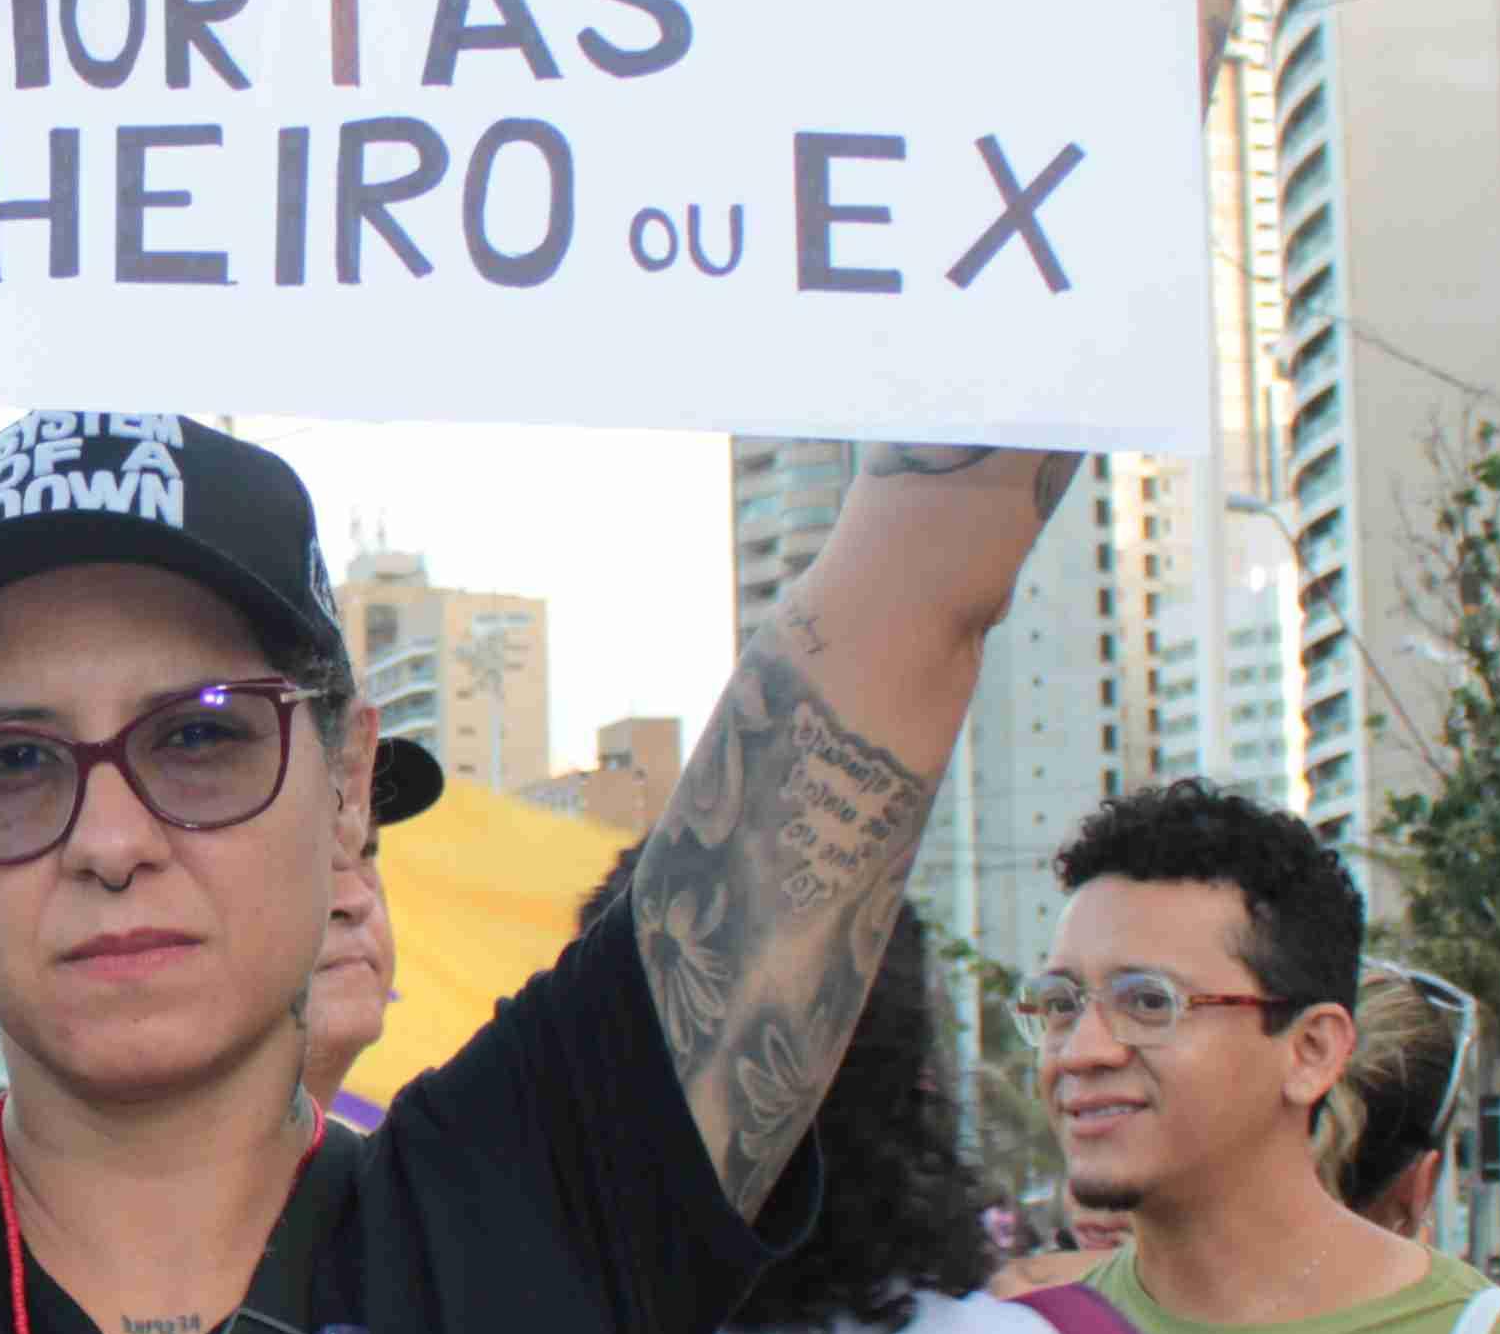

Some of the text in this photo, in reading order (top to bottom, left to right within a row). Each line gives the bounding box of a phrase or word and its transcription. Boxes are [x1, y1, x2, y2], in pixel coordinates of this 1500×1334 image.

[630, 204, 744, 276] OU
[794, 132, 1085, 295] EX
[120, 440, 182, 480] A
